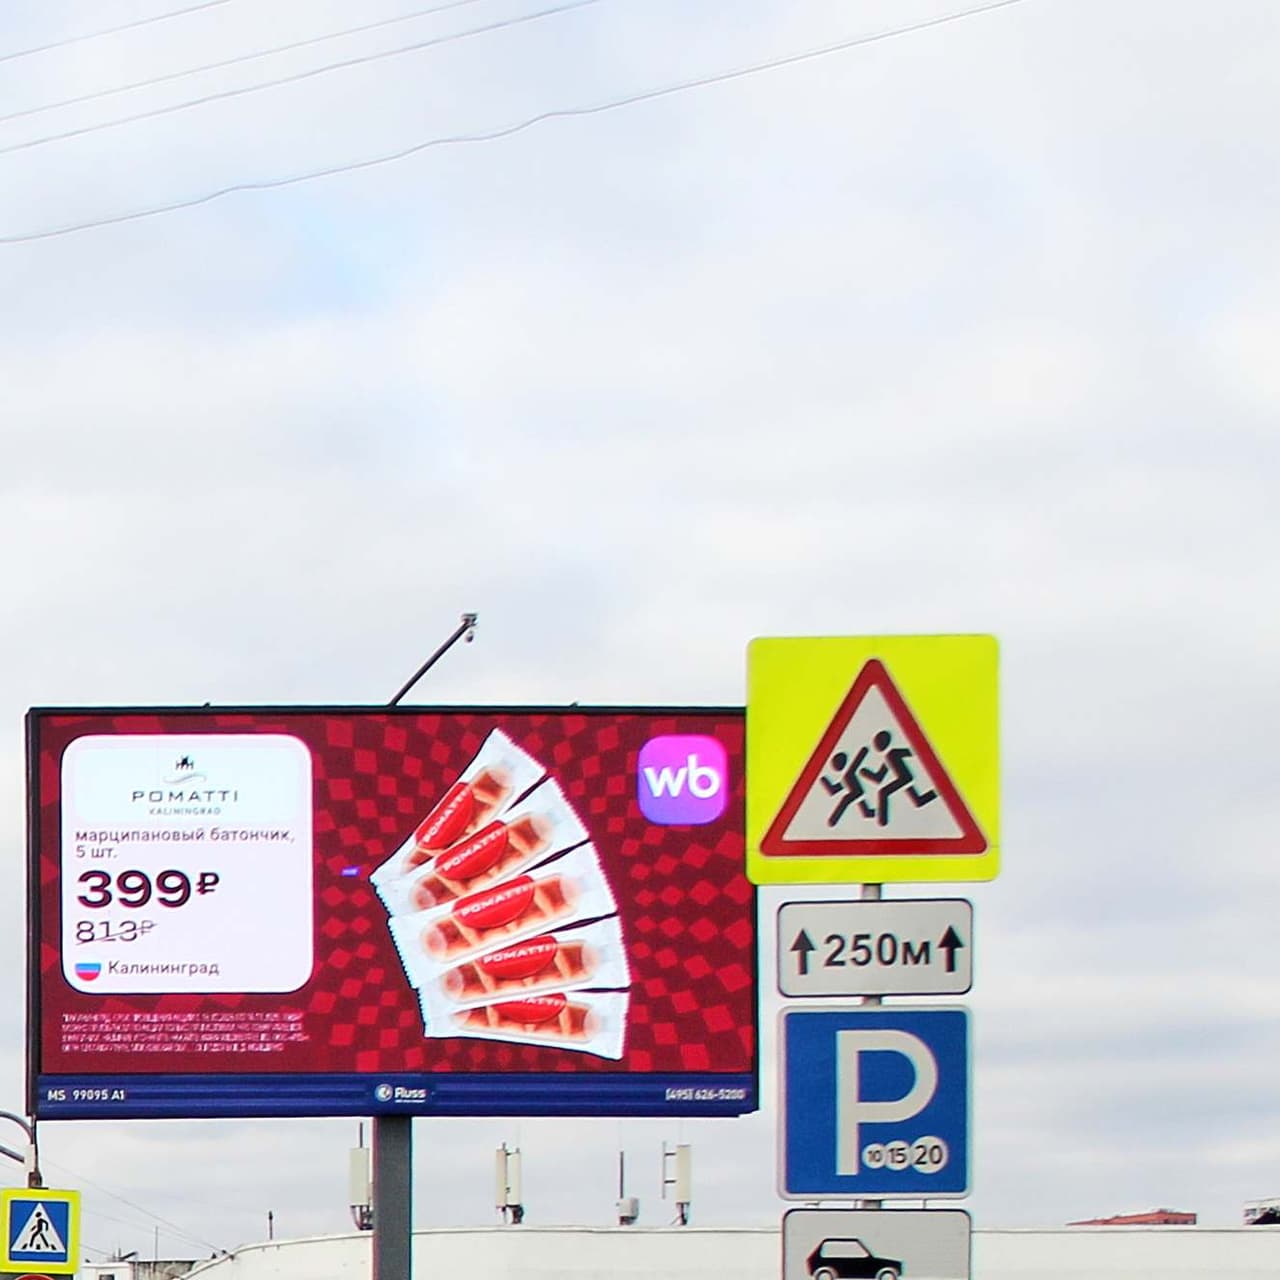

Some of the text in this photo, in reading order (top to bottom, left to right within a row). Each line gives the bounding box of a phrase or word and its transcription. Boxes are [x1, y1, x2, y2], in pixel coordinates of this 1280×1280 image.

[643, 754, 720, 798] wb
[131, 790, 239, 803] POMATTI
[75, 827, 295, 845] марципановый батончик,
[75, 846, 118, 859] 5 шт.
[461, 884, 533, 917] POMATTI
[483, 943, 557, 964] POMATTI
[108, 960, 220, 977] Калининград
[47, 1089, 125, 1100] MS 99095 A1
[394, 1087, 427, 1098] Russ
[836, 1029, 939, 1176] P
[868, 1144, 943, 1166] 10 15 20
